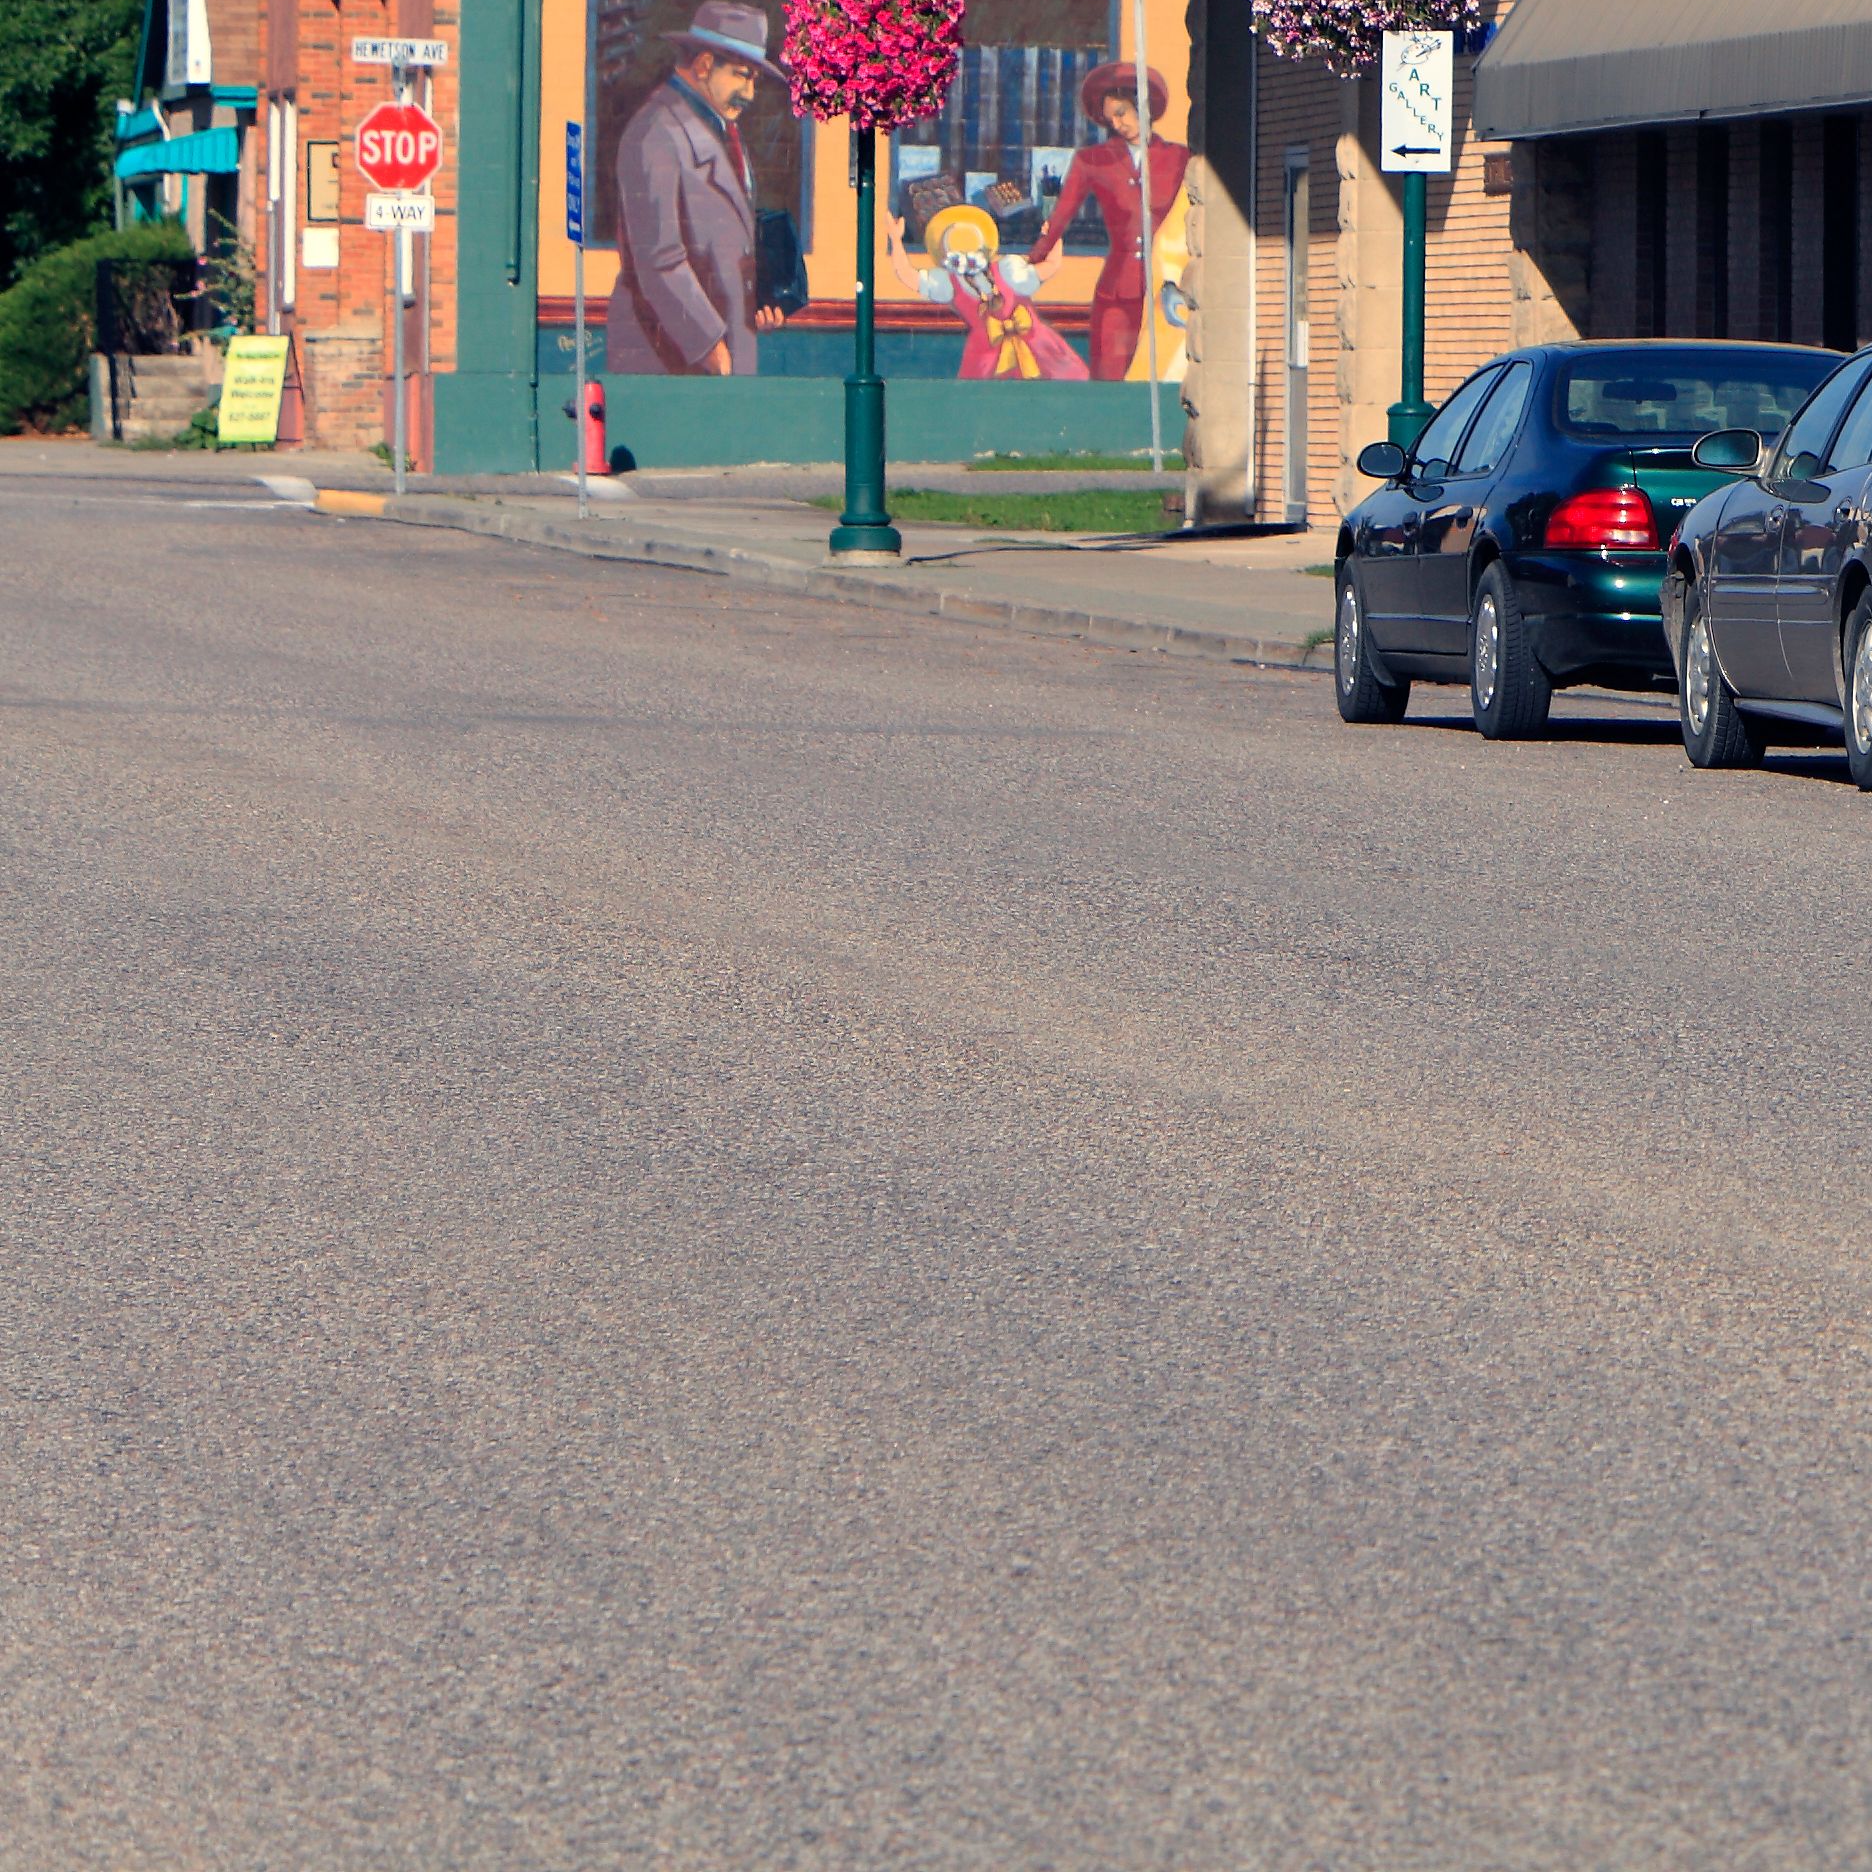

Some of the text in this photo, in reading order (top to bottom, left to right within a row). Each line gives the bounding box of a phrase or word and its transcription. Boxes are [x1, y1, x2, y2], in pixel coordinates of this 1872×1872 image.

[423, 43, 445, 60] AVE
[1408, 68, 1442, 111] ART
[1389, 82, 1444, 142] GALLERY
[362, 129, 438, 165] STOP
[375, 205, 426, 220] 4-WAY
